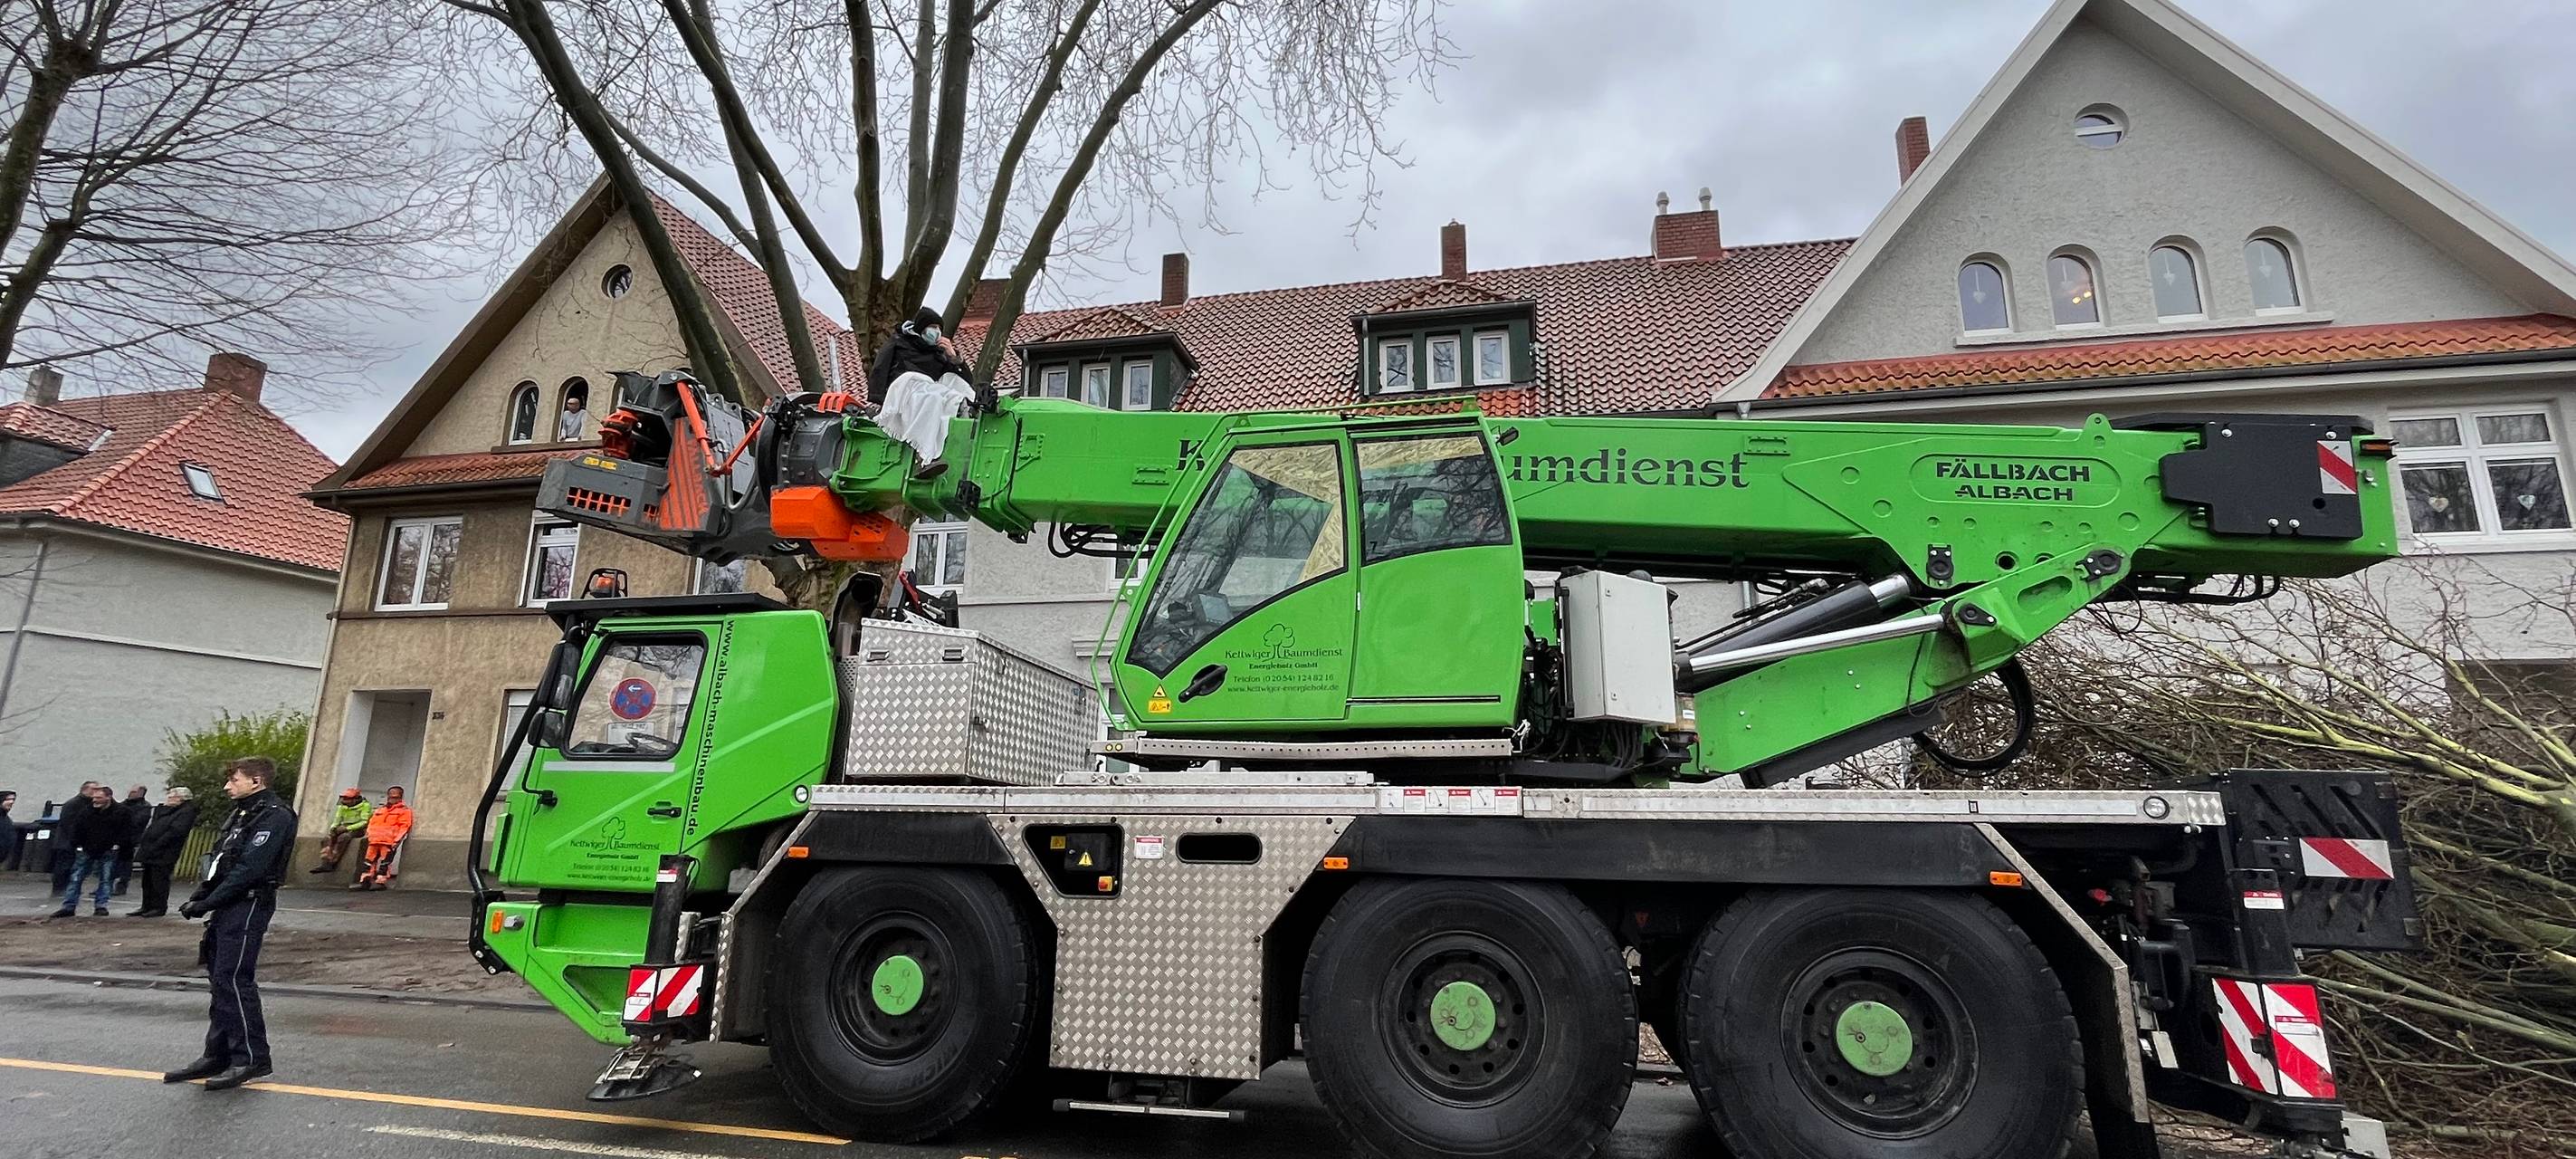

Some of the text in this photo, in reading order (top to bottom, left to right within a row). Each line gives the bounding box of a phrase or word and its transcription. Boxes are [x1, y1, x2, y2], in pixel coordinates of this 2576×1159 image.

[1502, 447, 1751, 489] umdienst
[1936, 458, 2090, 483] FÄLLBACH
[1954, 484, 2074, 502] ALBACH
[1225, 647, 1342, 660] Kettwiger Baumdienst
[686, 619, 735, 837] www.albach-maschinenbau.de
